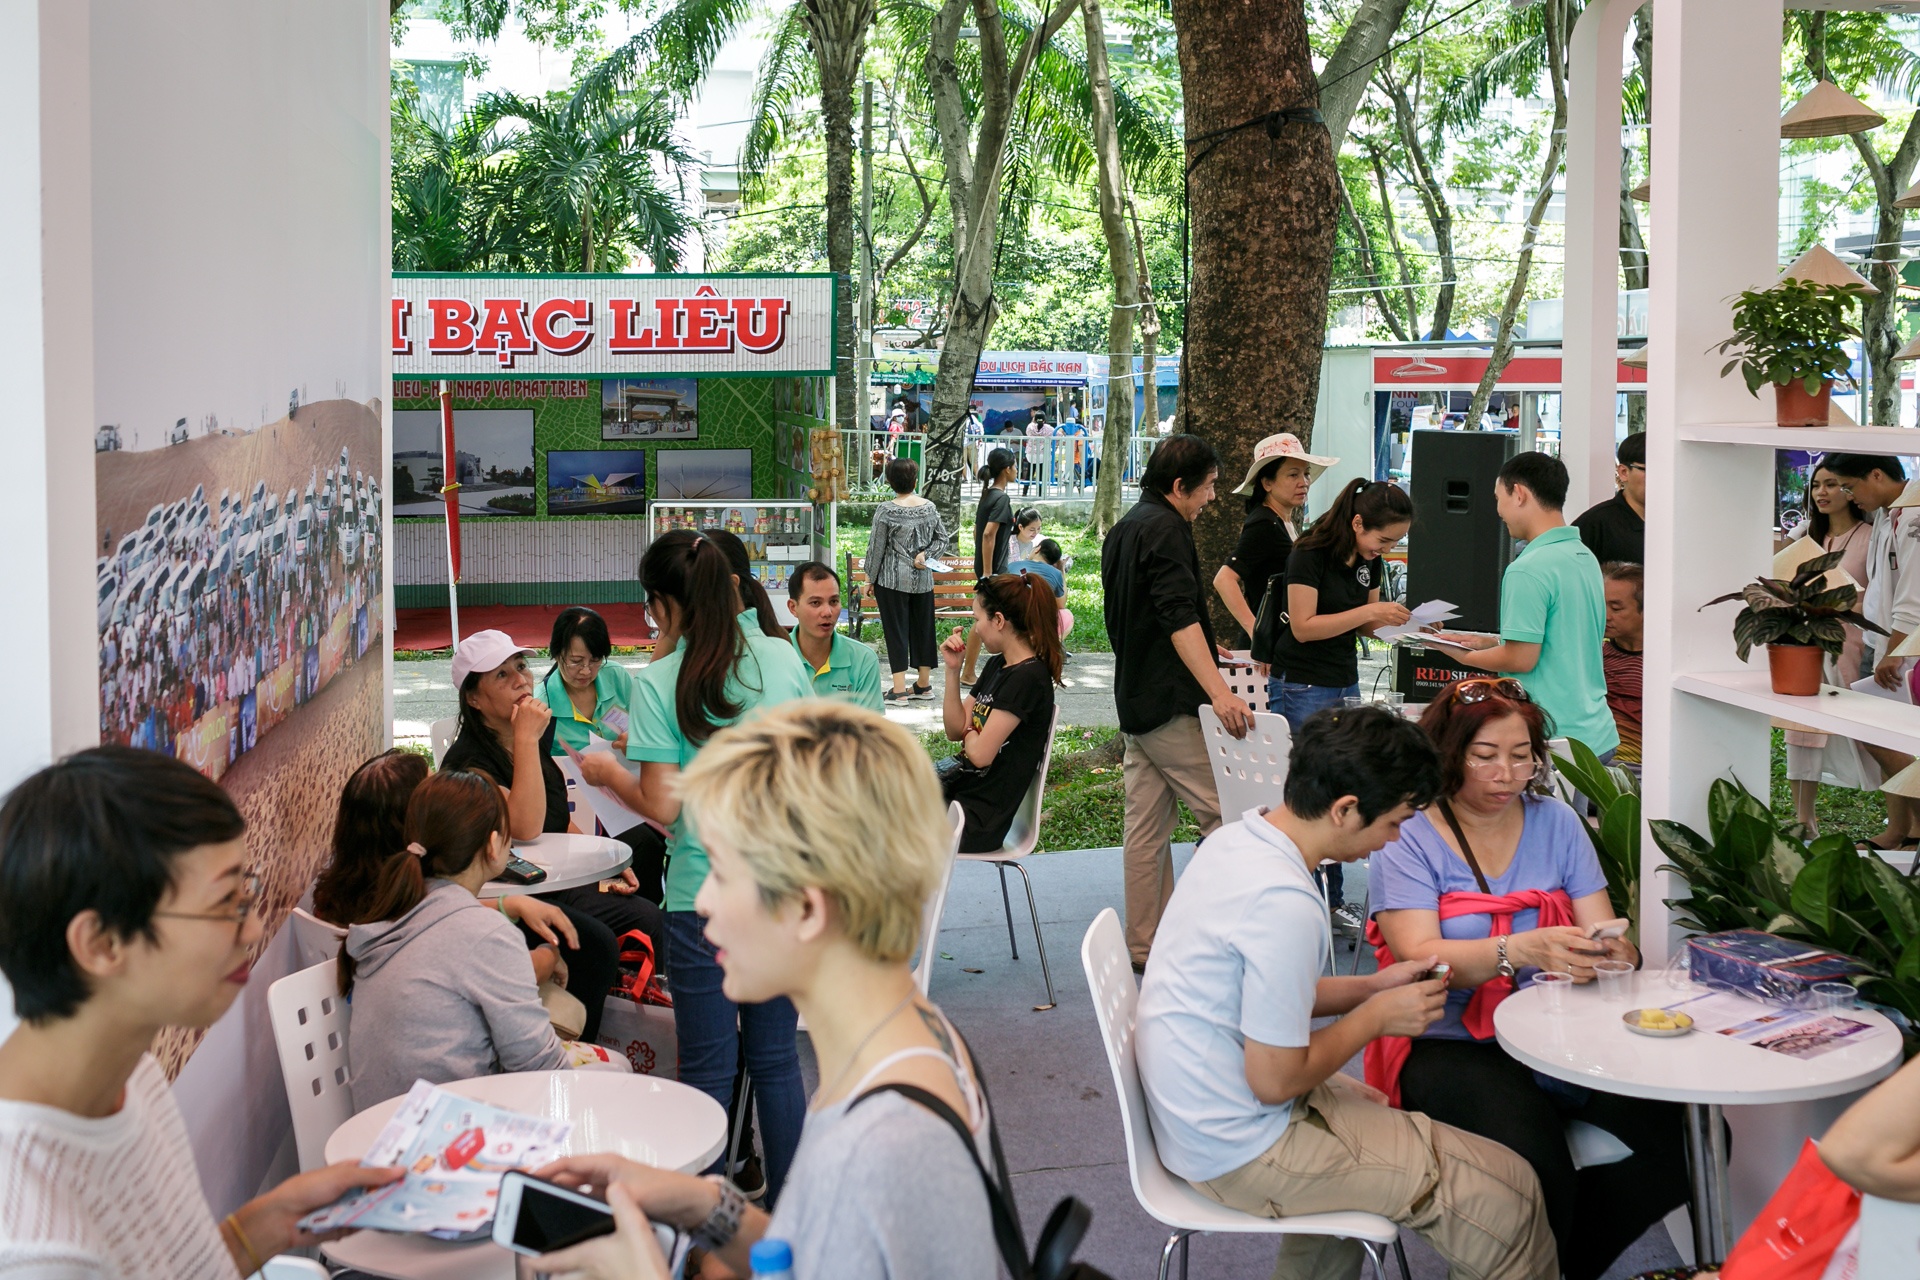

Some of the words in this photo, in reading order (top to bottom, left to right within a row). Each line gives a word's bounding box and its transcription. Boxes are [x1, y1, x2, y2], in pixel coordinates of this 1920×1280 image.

[427, 296, 595, 368] BẠC
[608, 285, 791, 355] LIÊU
[979, 361, 997, 372] DU
